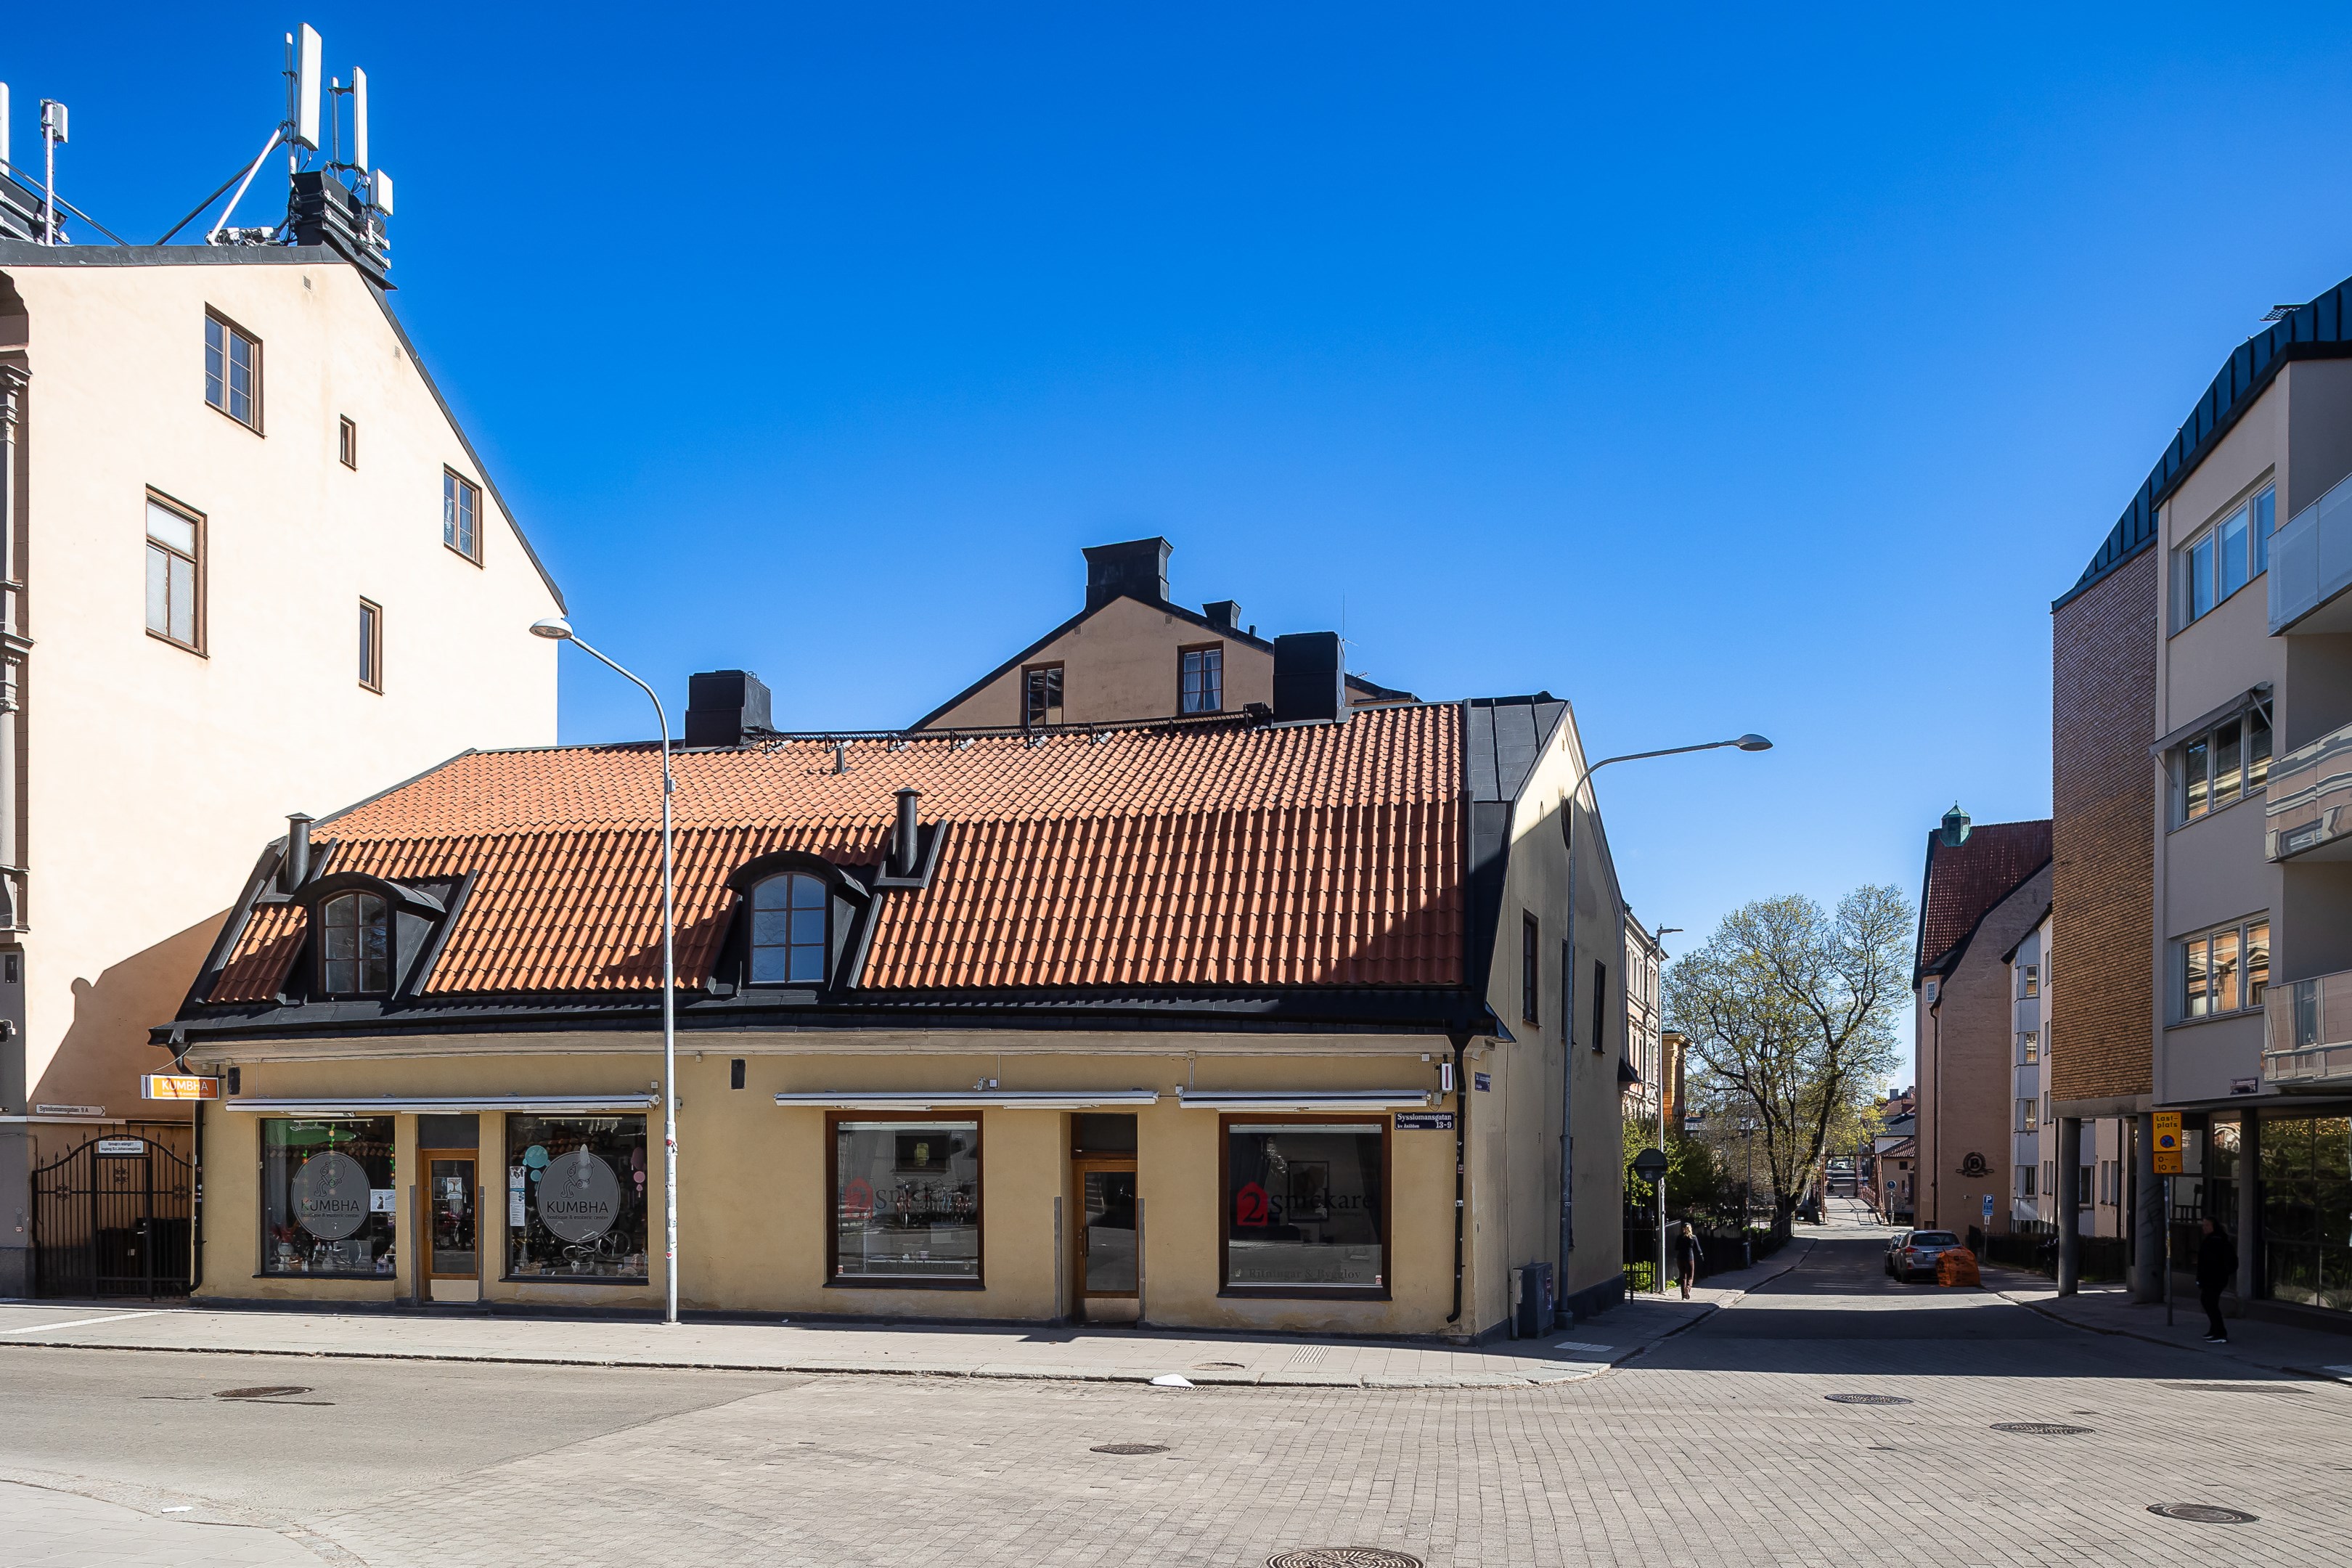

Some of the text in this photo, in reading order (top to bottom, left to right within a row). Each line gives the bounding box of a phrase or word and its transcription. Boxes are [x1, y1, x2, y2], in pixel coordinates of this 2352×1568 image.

[162, 1079, 208, 1091] KUMBHA
[1397, 1113, 1452, 1122] Sysslomansgatan
[301, 1199, 360, 1212] KUMBHA
[547, 1201, 609, 1213] KUMBHA
[1242, 1187, 1371, 1223] 2 snickare
[1249, 1268, 1301, 1281] Ritningar
